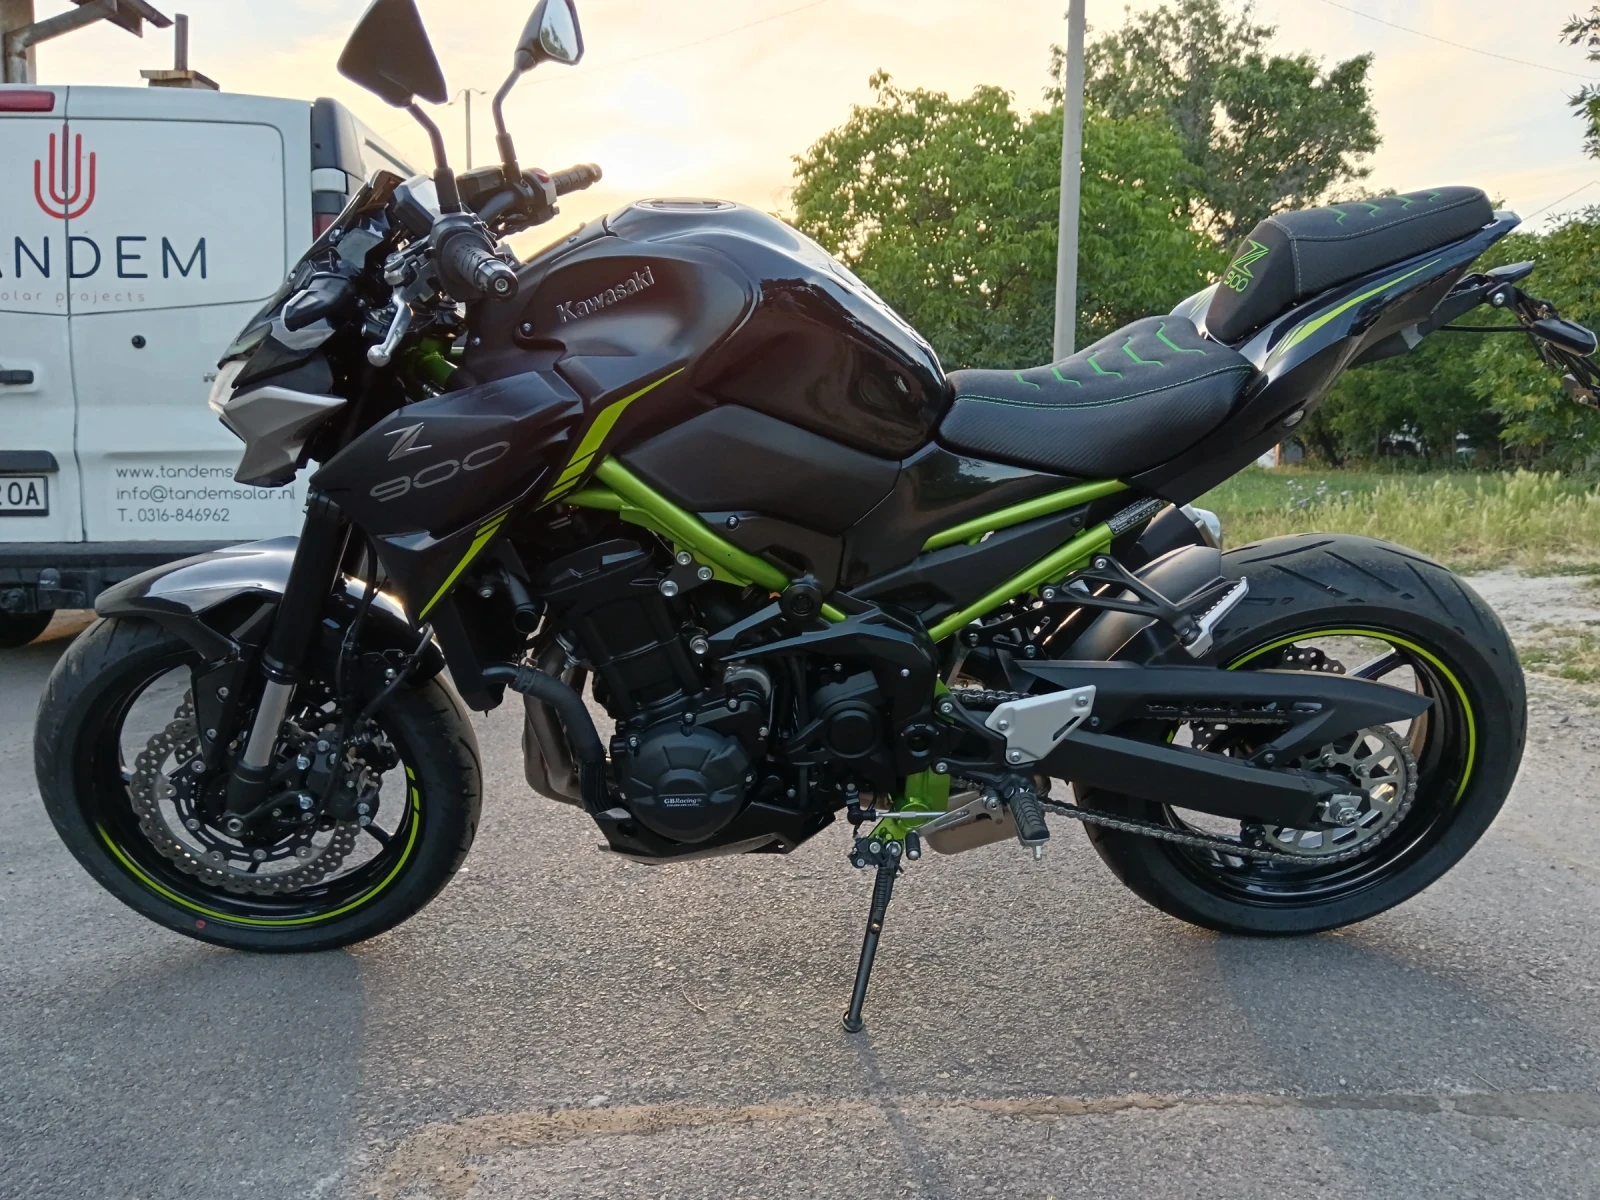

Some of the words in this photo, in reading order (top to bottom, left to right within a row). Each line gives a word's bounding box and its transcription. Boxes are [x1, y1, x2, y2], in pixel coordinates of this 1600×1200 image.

[0, 235, 207, 279] NDEM
[1223, 270, 1249, 293] 900
[55, 290, 146, 305] projects
[556, 265, 655, 323] Kawasaki
[115, 464, 238, 479] www.tandems
[369, 440, 511, 502] 900
[116, 485, 296, 502] info@tandemsolar.nl
[117, 508, 133, 522] T.
[137, 508, 231, 523] 0316-846962
